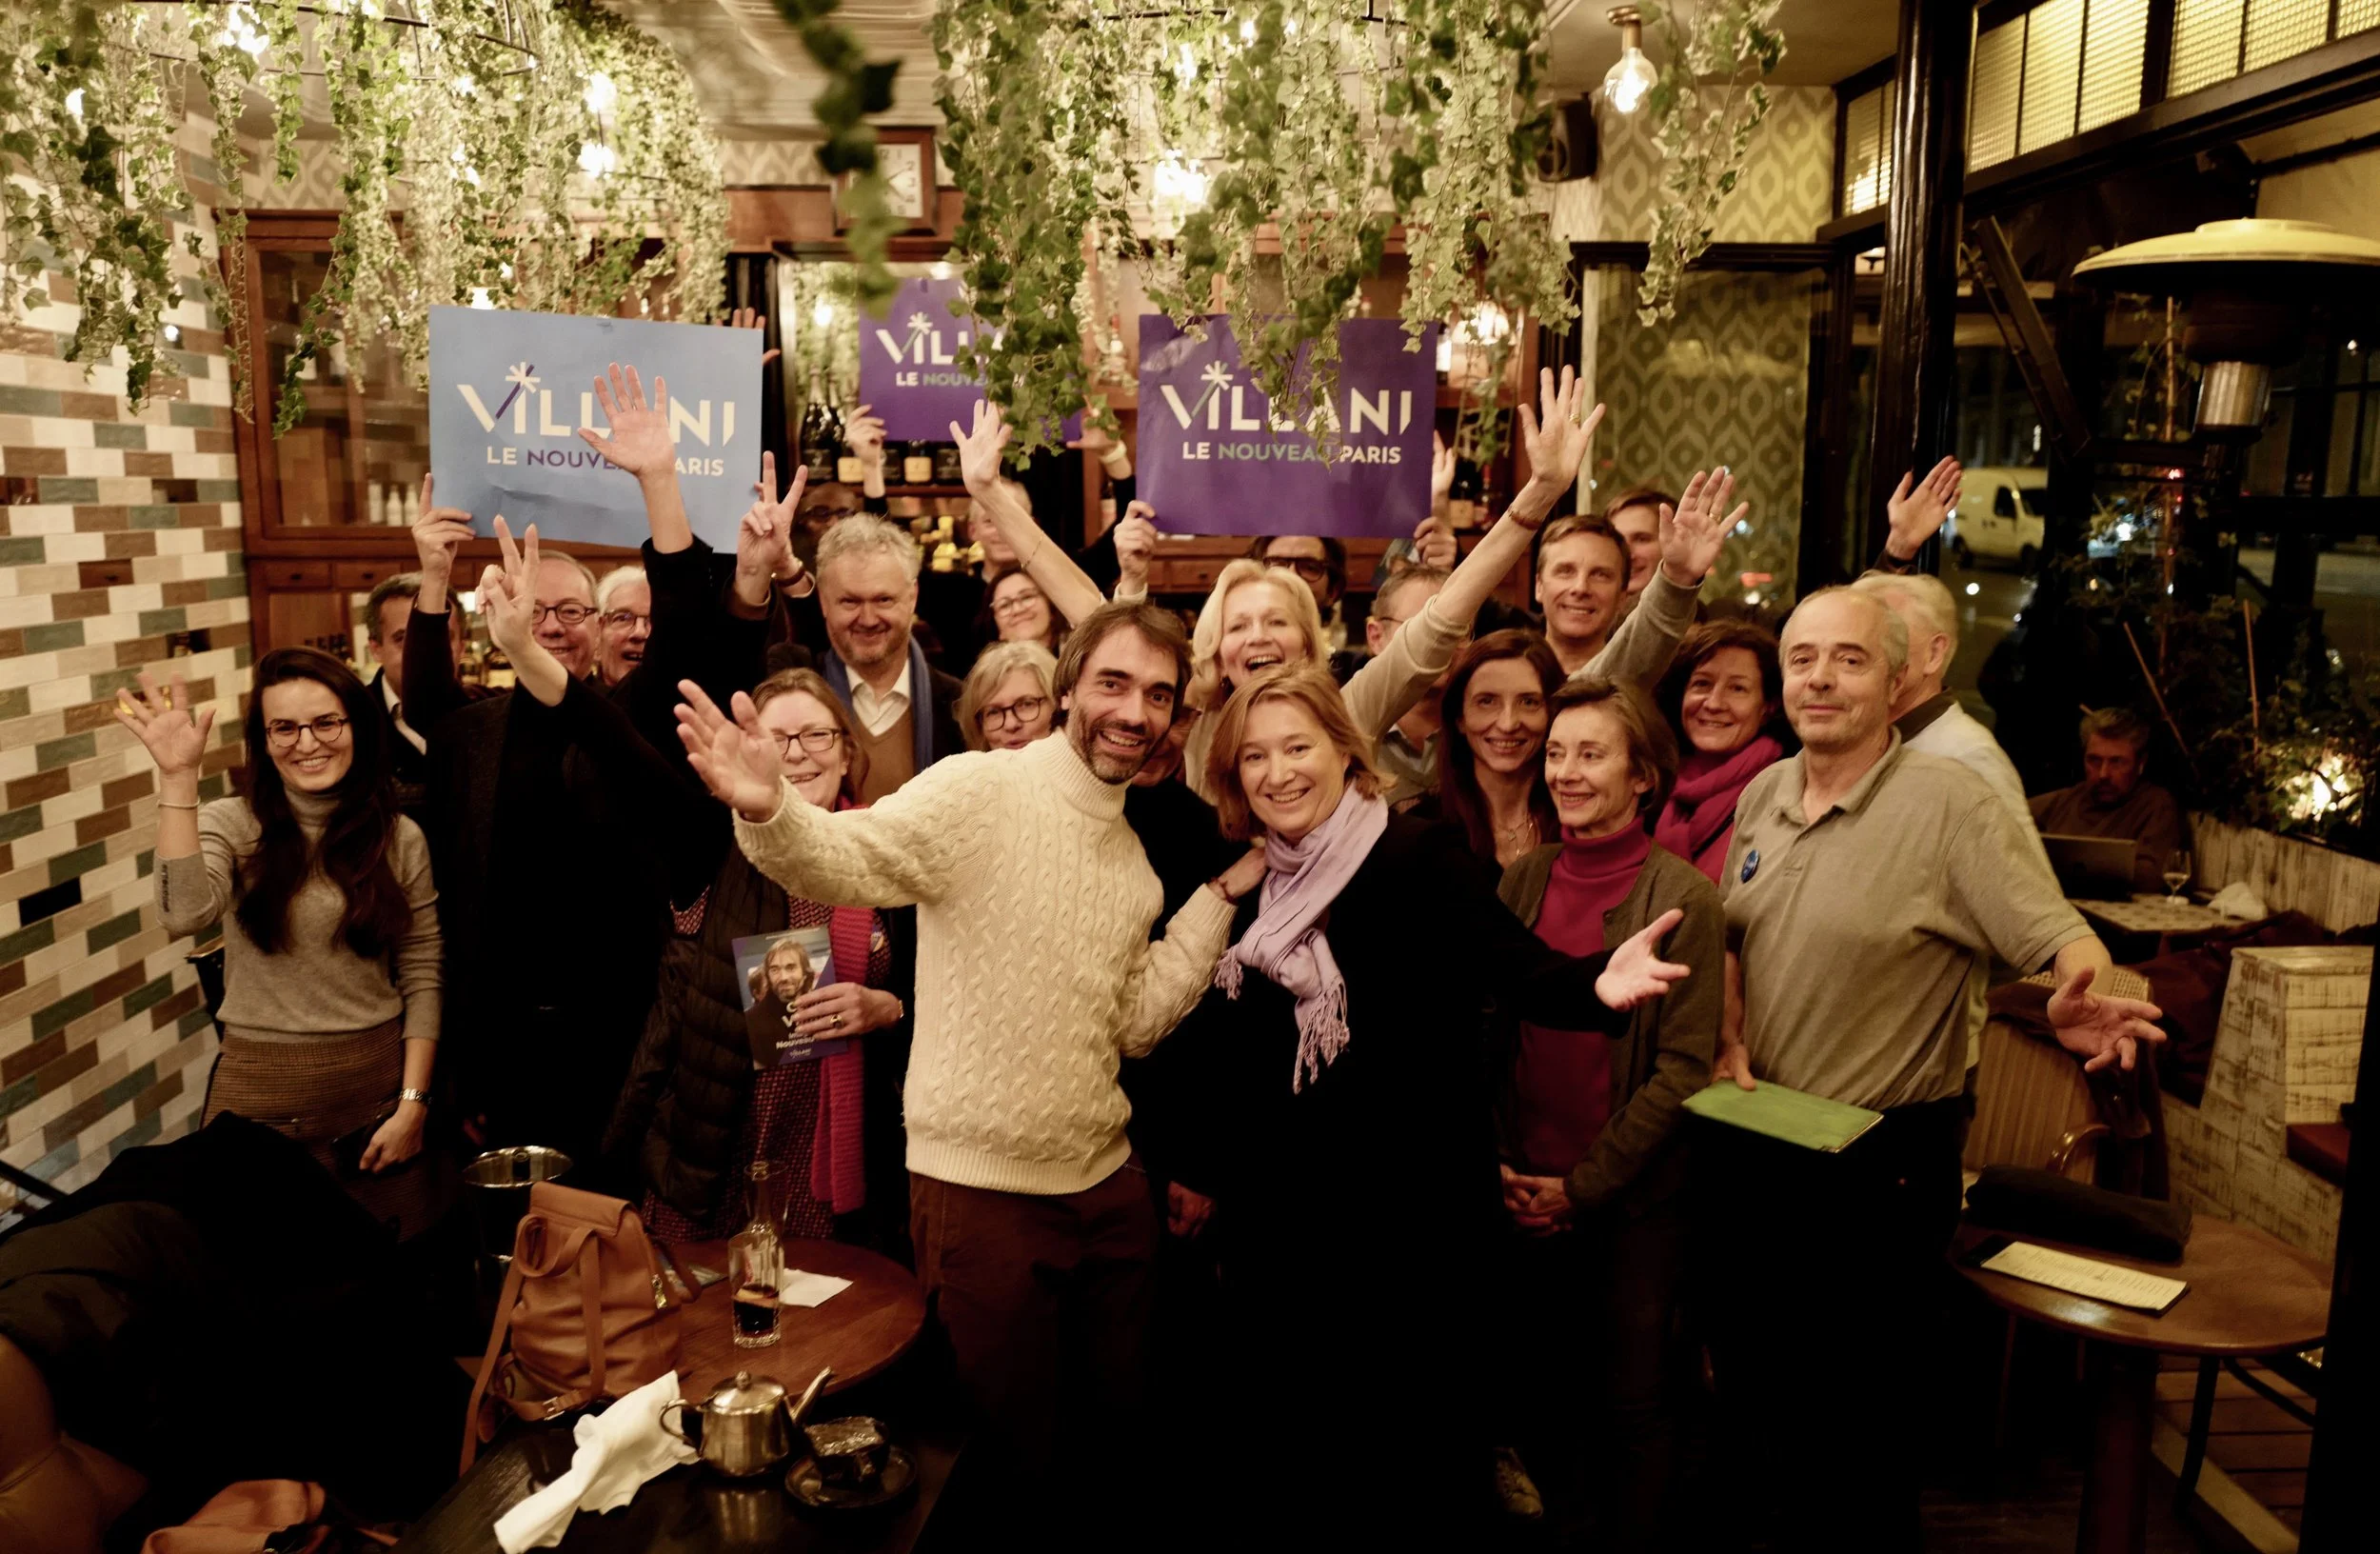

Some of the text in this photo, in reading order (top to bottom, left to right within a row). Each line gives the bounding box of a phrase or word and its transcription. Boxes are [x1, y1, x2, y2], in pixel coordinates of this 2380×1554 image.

[896, 372, 919, 387] LE
[457, 362, 735, 448] VILLNI
[1160, 360, 1413, 436] VILLANI
[486, 447, 517, 466] LE
[674, 457, 724, 476] ARIS
[1182, 441, 1211, 460] LE
[1339, 445, 1402, 465] PARIS
